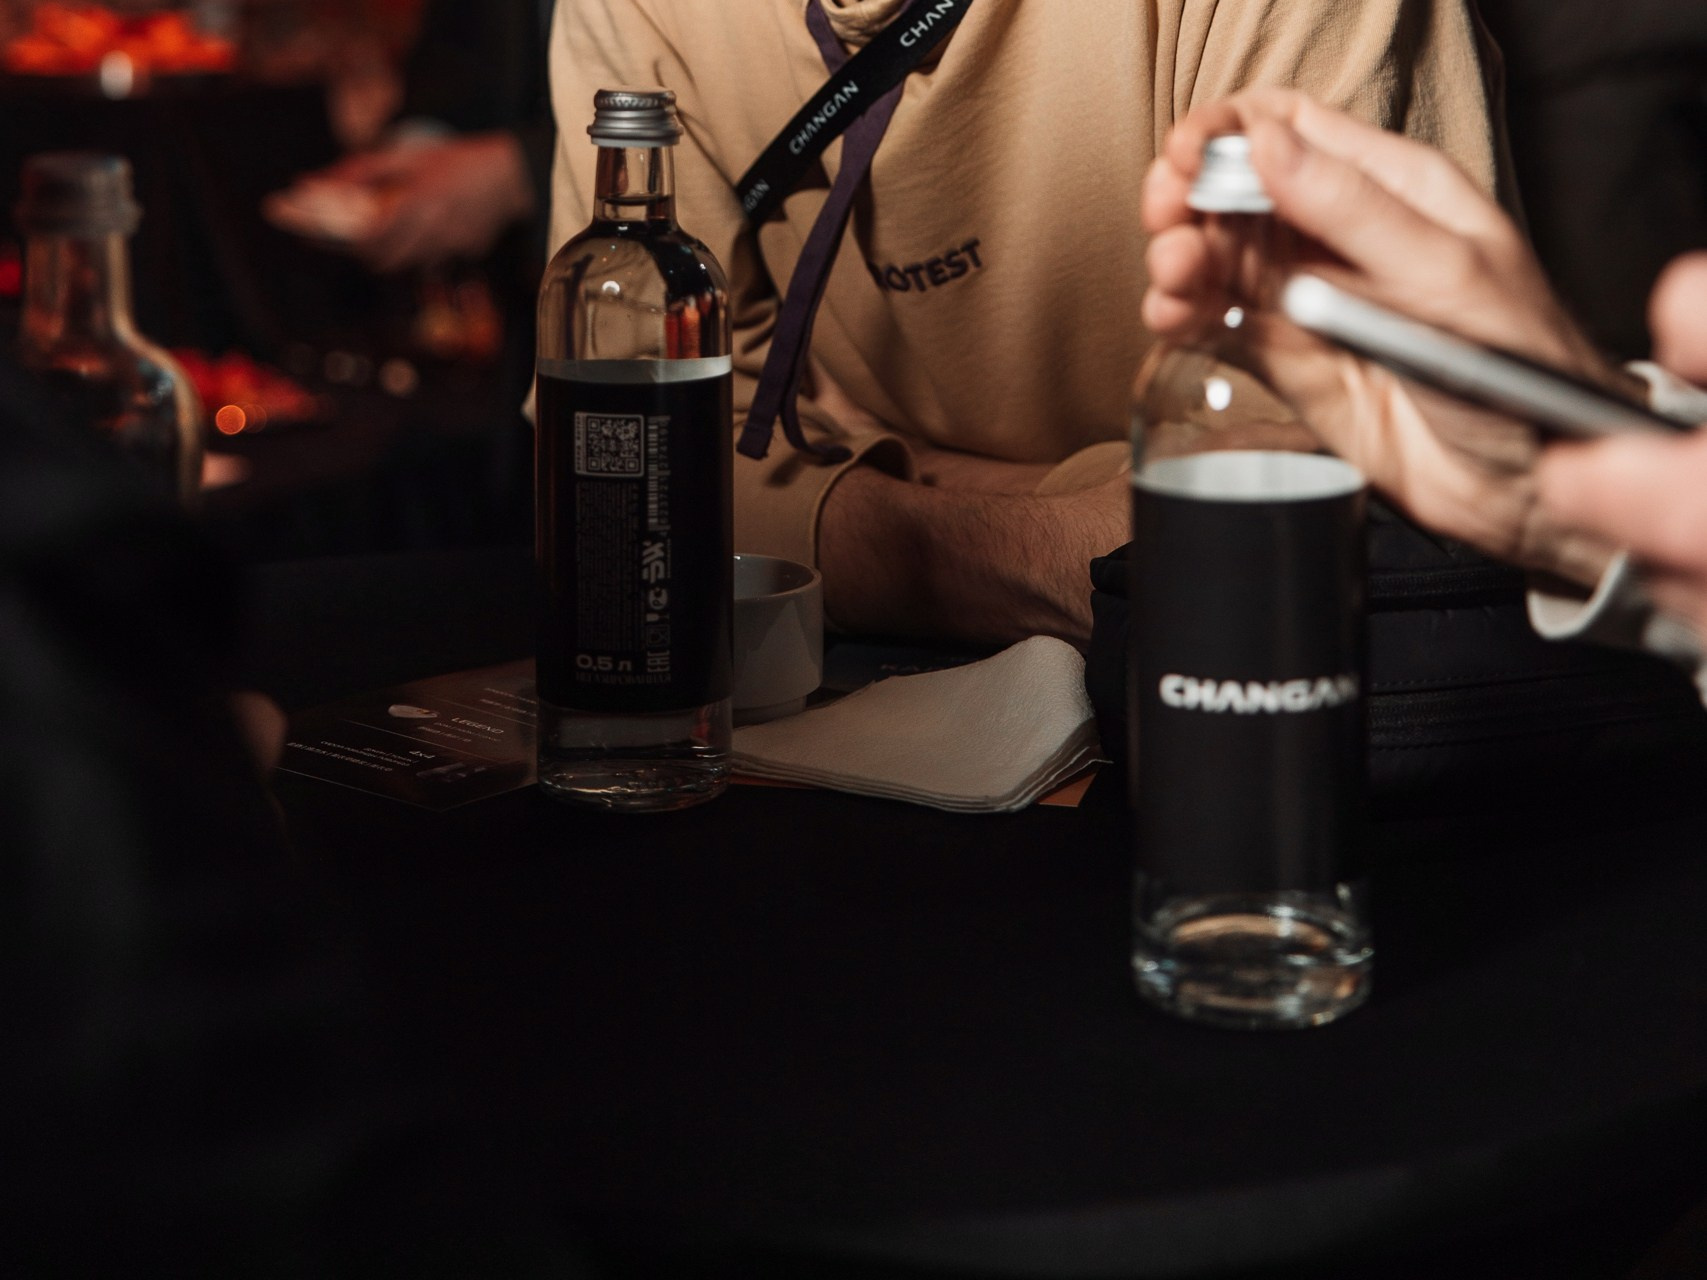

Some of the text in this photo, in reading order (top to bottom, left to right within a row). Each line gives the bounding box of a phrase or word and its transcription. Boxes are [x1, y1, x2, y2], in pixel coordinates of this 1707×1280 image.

[789, 80, 859, 155] CHANGAN
[876, 238, 982, 292] OTEST
[576, 654, 632, 672] 0,5 л
[1159, 673, 1359, 715] CHANGAN
